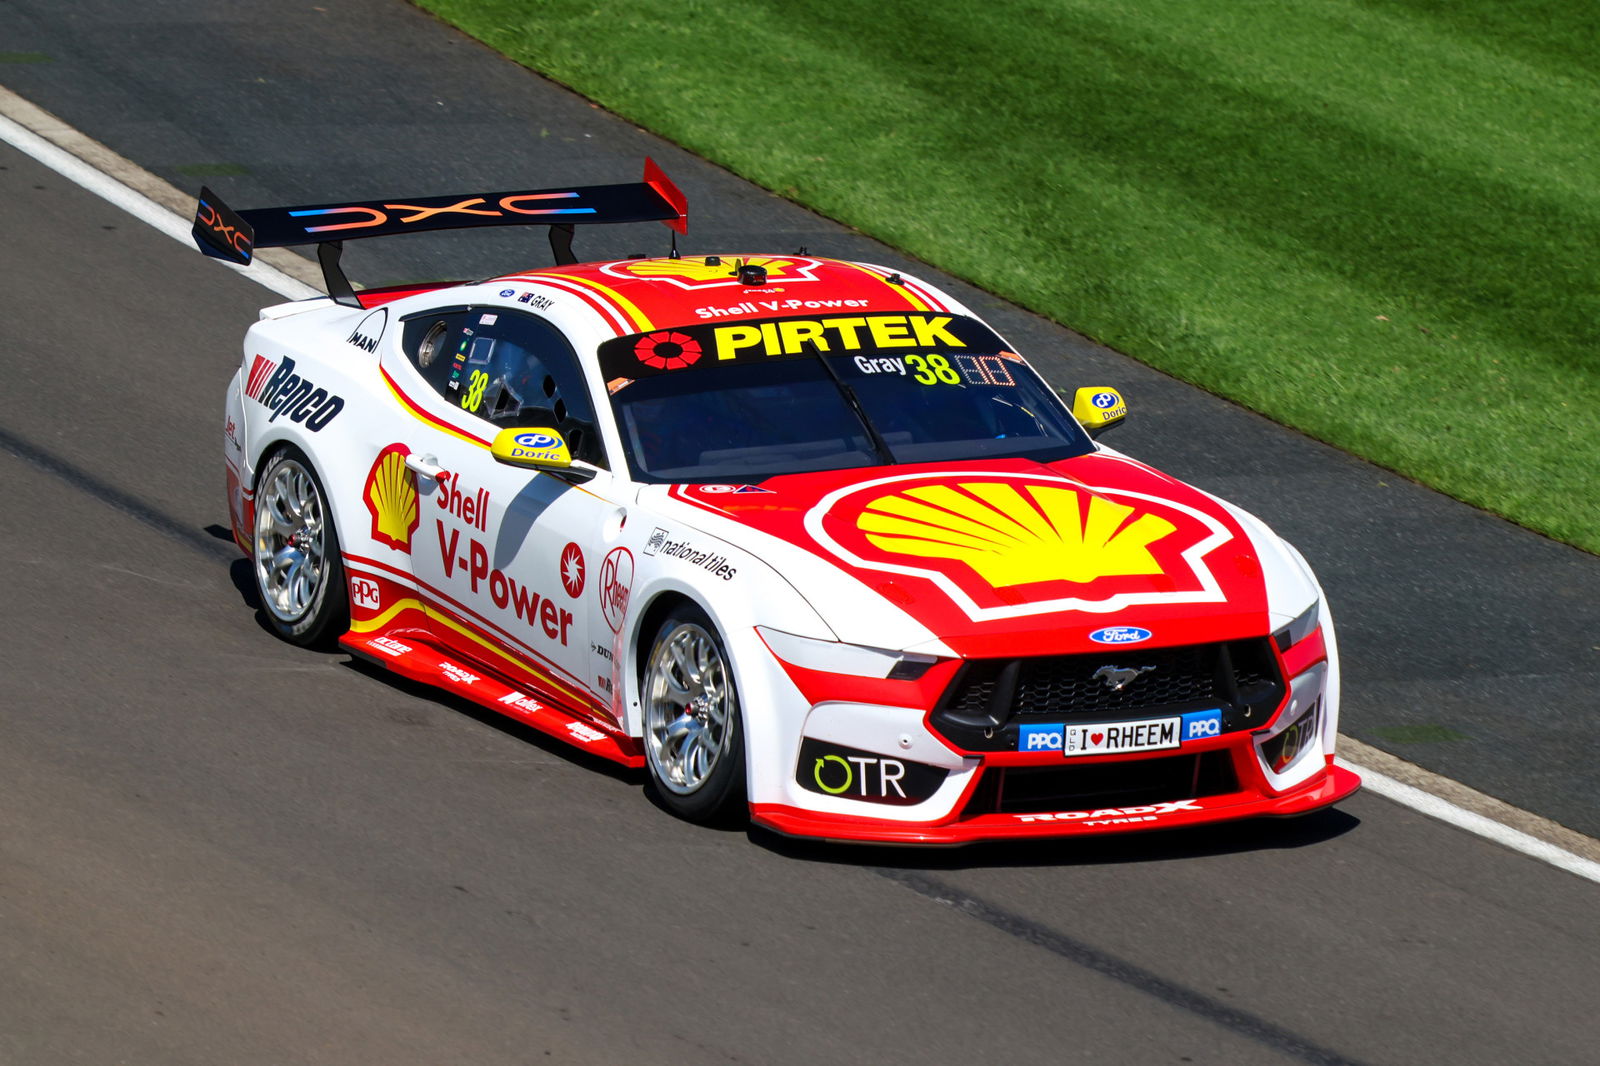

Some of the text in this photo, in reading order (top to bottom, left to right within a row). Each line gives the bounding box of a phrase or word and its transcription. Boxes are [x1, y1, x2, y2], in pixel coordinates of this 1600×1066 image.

[288, 192, 597, 233] DXC
[198, 200, 251, 259] DXC
[531, 295, 556, 311] GRAY
[695, 299, 869, 319] Shell V-Power
[350, 332, 377, 353] MAN
[713, 315, 967, 361] PIRTEK
[853, 354, 961, 386] Gray 38
[258, 355, 345, 433] Repco
[461, 369, 489, 413] 38
[1102, 406, 1127, 421] Doric
[511, 448, 561, 461] Doric
[437, 470, 490, 533] Shell
[660, 539, 737, 581] national tiles
[352, 580, 379, 604] PPG
[437, 518, 573, 647] V-Power
[1102, 628, 1141, 642] Ford
[1027, 732, 1062, 750] PPQ
[1080, 722, 1175, 751] I RHEEM
[1189, 718, 1220, 738] PPQ
[814, 754, 907, 799] OTR
[1013, 799, 1204, 823] ROADX
[1083, 815, 1158, 827] TYRES
